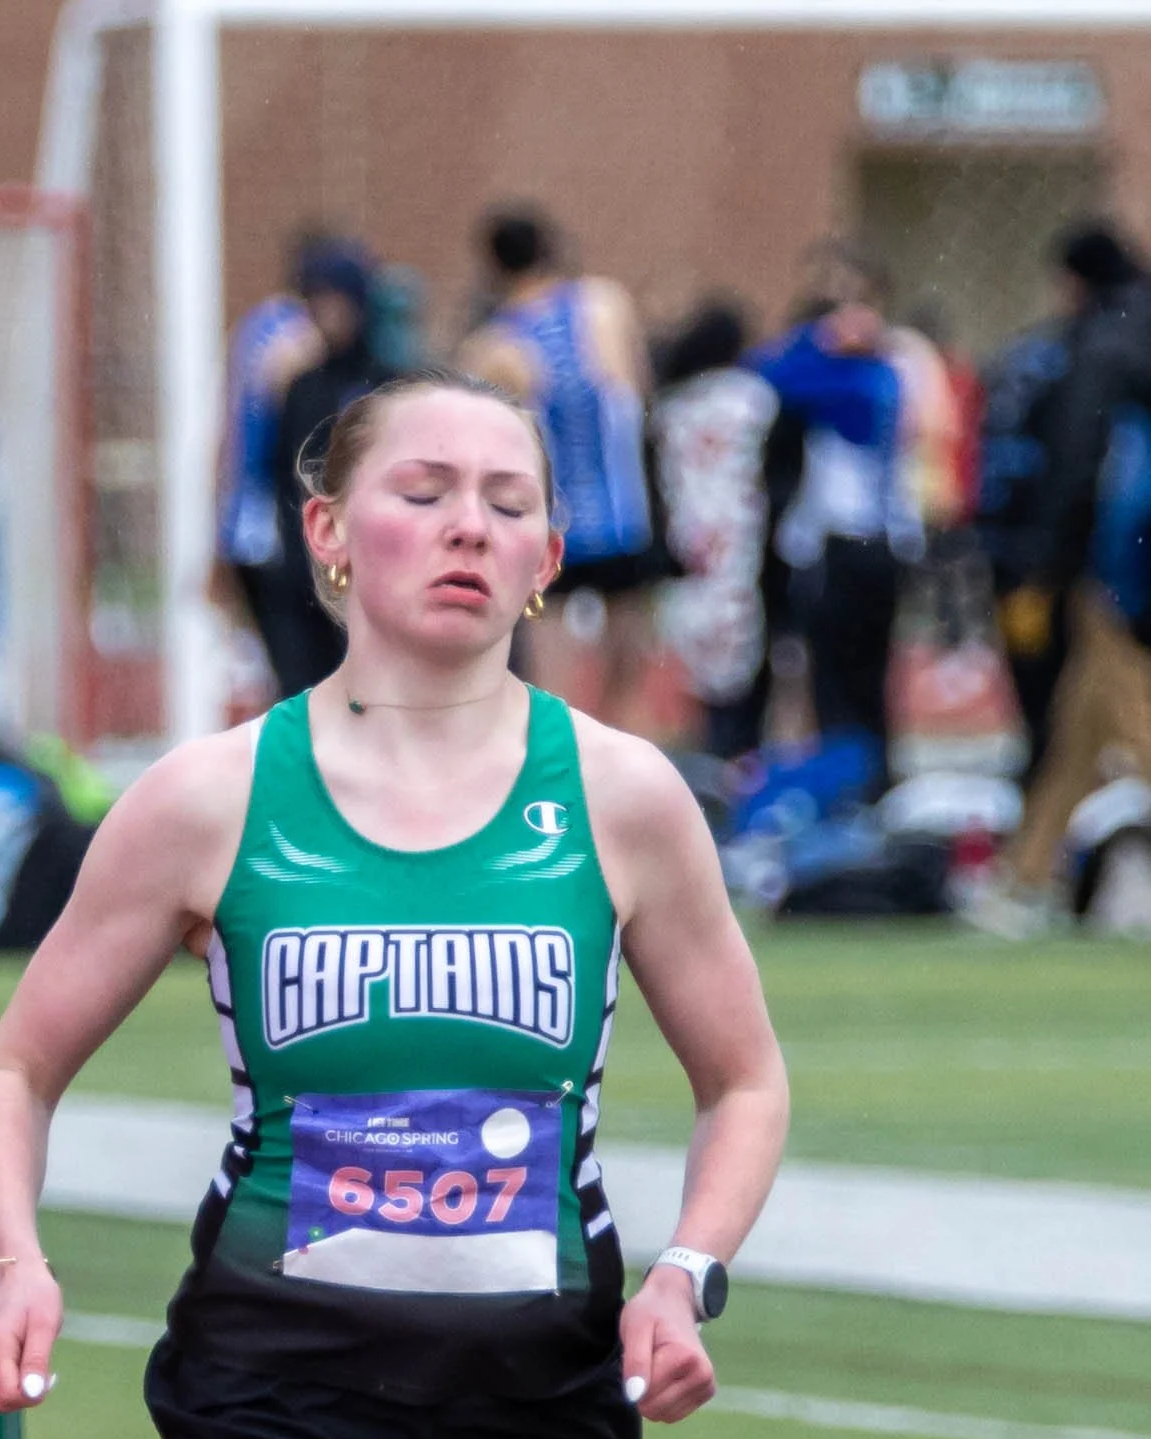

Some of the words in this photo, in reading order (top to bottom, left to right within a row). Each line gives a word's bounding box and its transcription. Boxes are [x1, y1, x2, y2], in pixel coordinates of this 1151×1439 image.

[262, 924, 575, 1050] CAPTAINS
[325, 1130, 400, 1145] CHICAGO
[402, 1131, 459, 1145] SPRING
[329, 1166, 527, 1225] 6507
